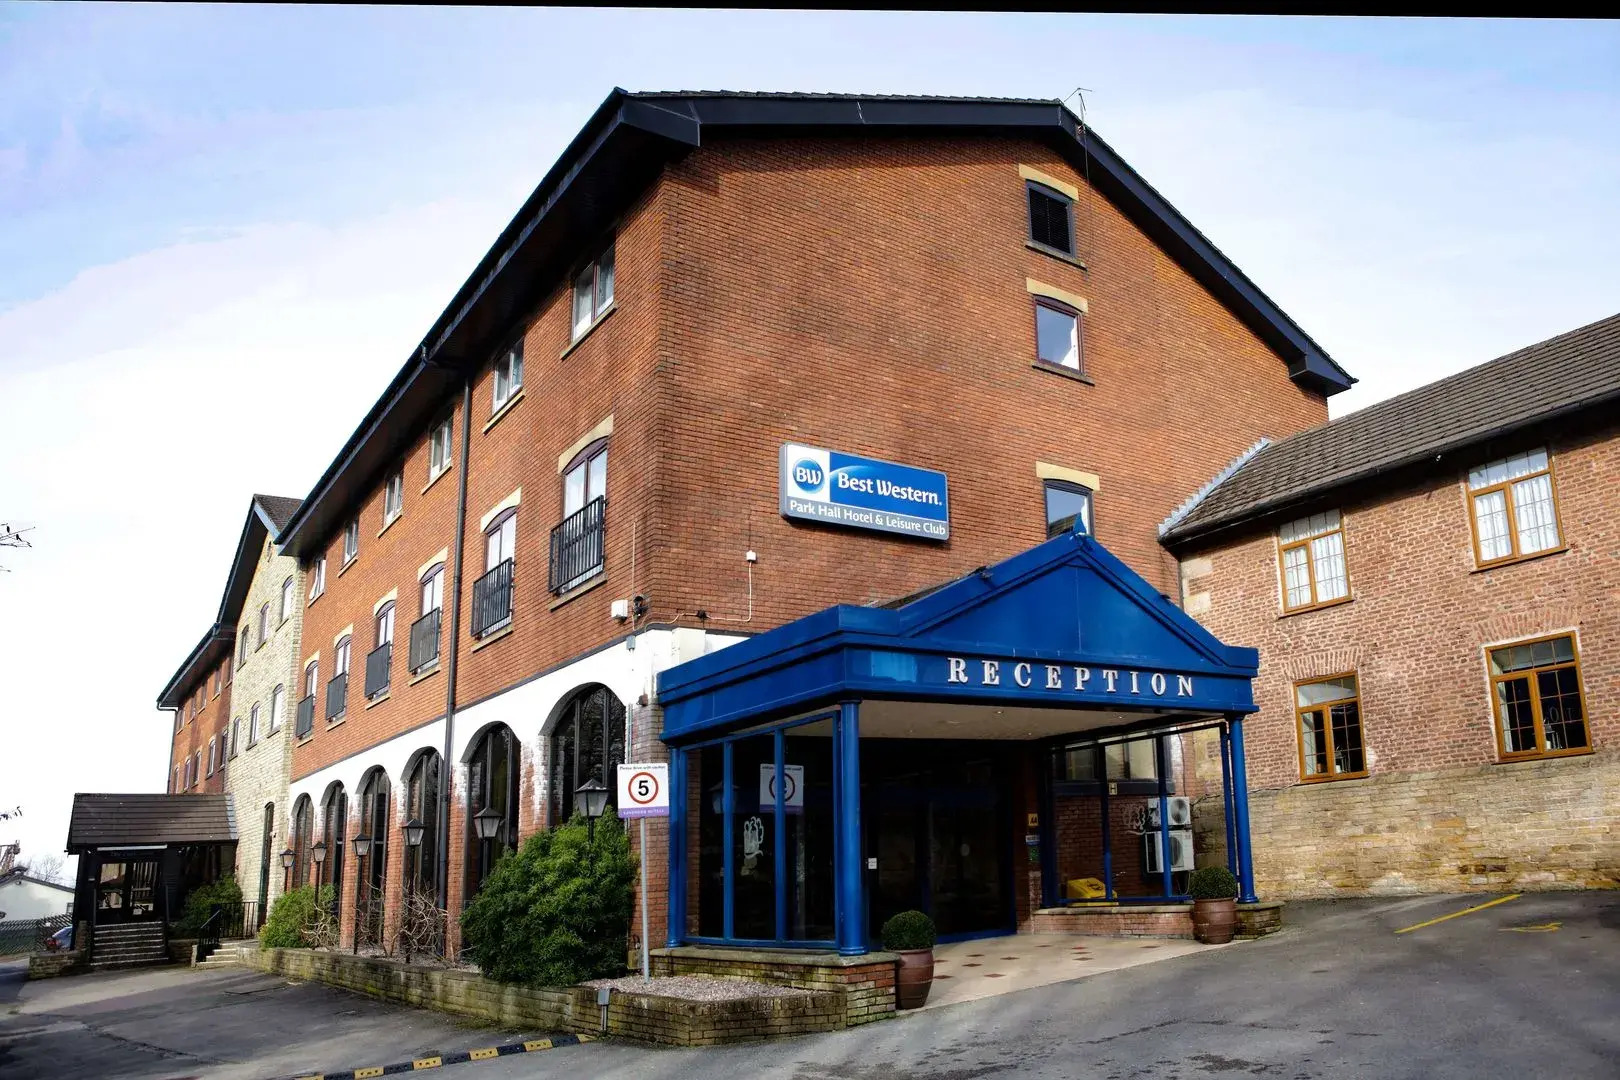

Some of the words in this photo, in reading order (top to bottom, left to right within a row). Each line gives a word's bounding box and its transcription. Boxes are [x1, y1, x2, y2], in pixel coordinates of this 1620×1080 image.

[796, 467, 822, 485] BW
[838, 472, 874, 494] Best
[790, 500, 815, 514] Park
[819, 504, 841, 519] Hall
[844, 508, 873, 524] Hotel
[875, 514, 884, 526] &
[886, 516, 921, 532] Leisure
[923, 522, 946, 536] Club
[947, 657, 1193, 697] RECEPTION
[638, 780, 649, 796] 5
